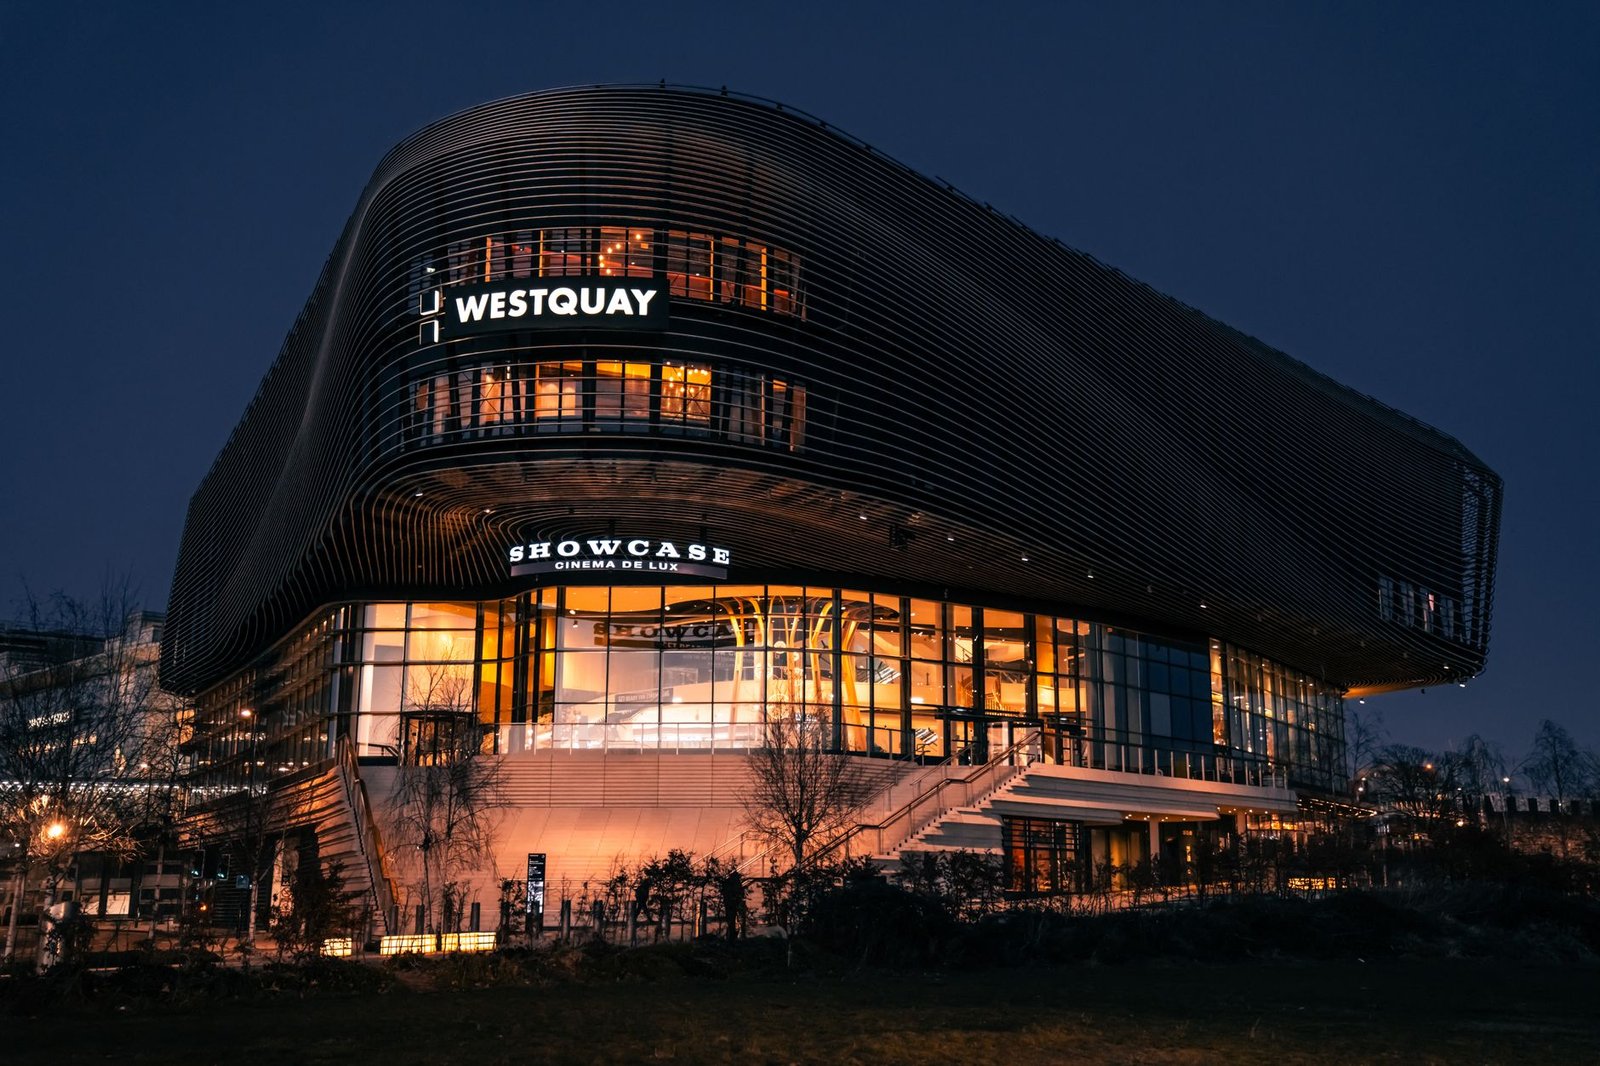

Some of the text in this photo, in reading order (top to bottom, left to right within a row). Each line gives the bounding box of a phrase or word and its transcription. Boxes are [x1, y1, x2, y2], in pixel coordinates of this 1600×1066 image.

[455, 287, 657, 323] WESTQUAY
[509, 540, 730, 565] SHOWCASE
[554, 560, 678, 572] CINEMA DE LUX
[593, 622, 757, 639] SHOWCA
